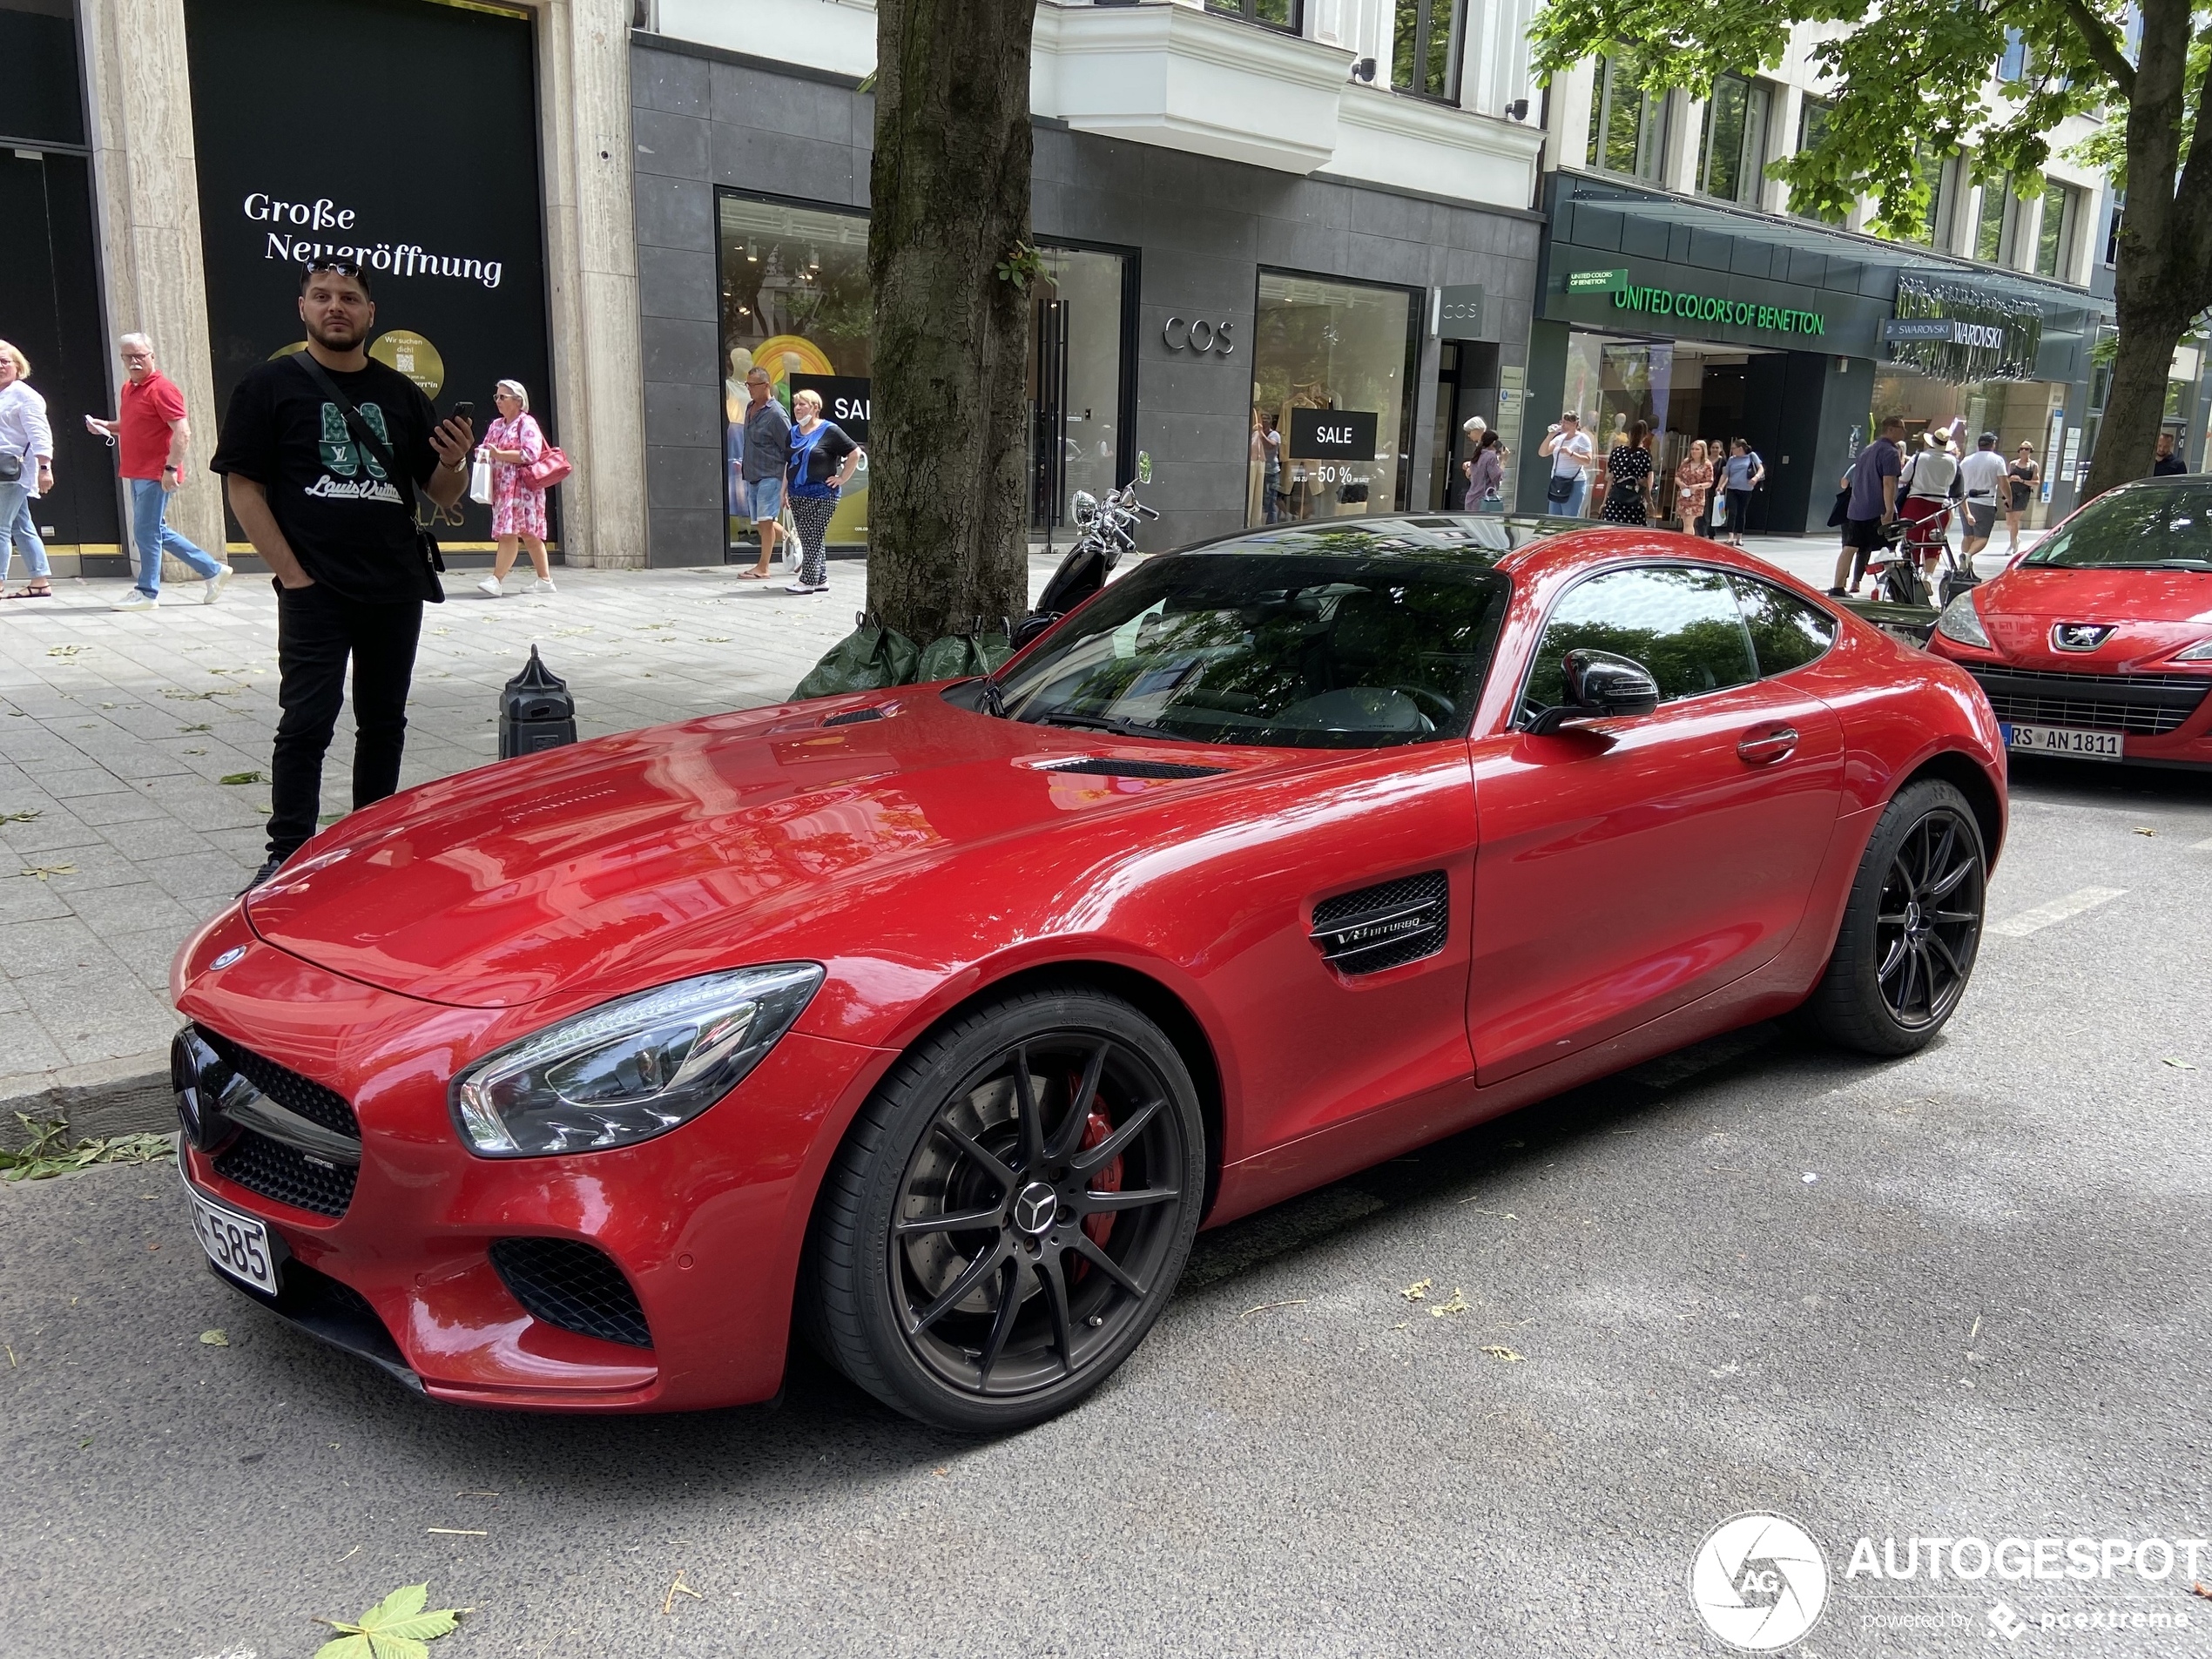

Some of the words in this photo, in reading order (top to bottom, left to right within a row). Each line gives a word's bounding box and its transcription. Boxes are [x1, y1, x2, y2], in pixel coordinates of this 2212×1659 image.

[244, 192, 355, 231] Große
[1442, 303, 1477, 320] COS
[1615, 285, 1672, 314] UNITED
[1675, 293, 1733, 324] COLORS
[1736, 302, 1756, 326] OF
[1163, 316, 1234, 355] COS
[1898, 324, 1949, 334] SWAROVSKI
[1953, 321, 2003, 348] WAROVSKI
[834, 397, 870, 421] SAL
[1316, 426, 1353, 444] SALE
[305, 475, 361, 499] Louis
[360, 479, 404, 505] Vuitto
[2010, 727, 2033, 745] RS
[2046, 731, 2069, 750] AN
[2073, 733, 2118, 755] 1811
[1337, 927, 1368, 945] V8
[1369, 917, 1420, 937] BITURBO
